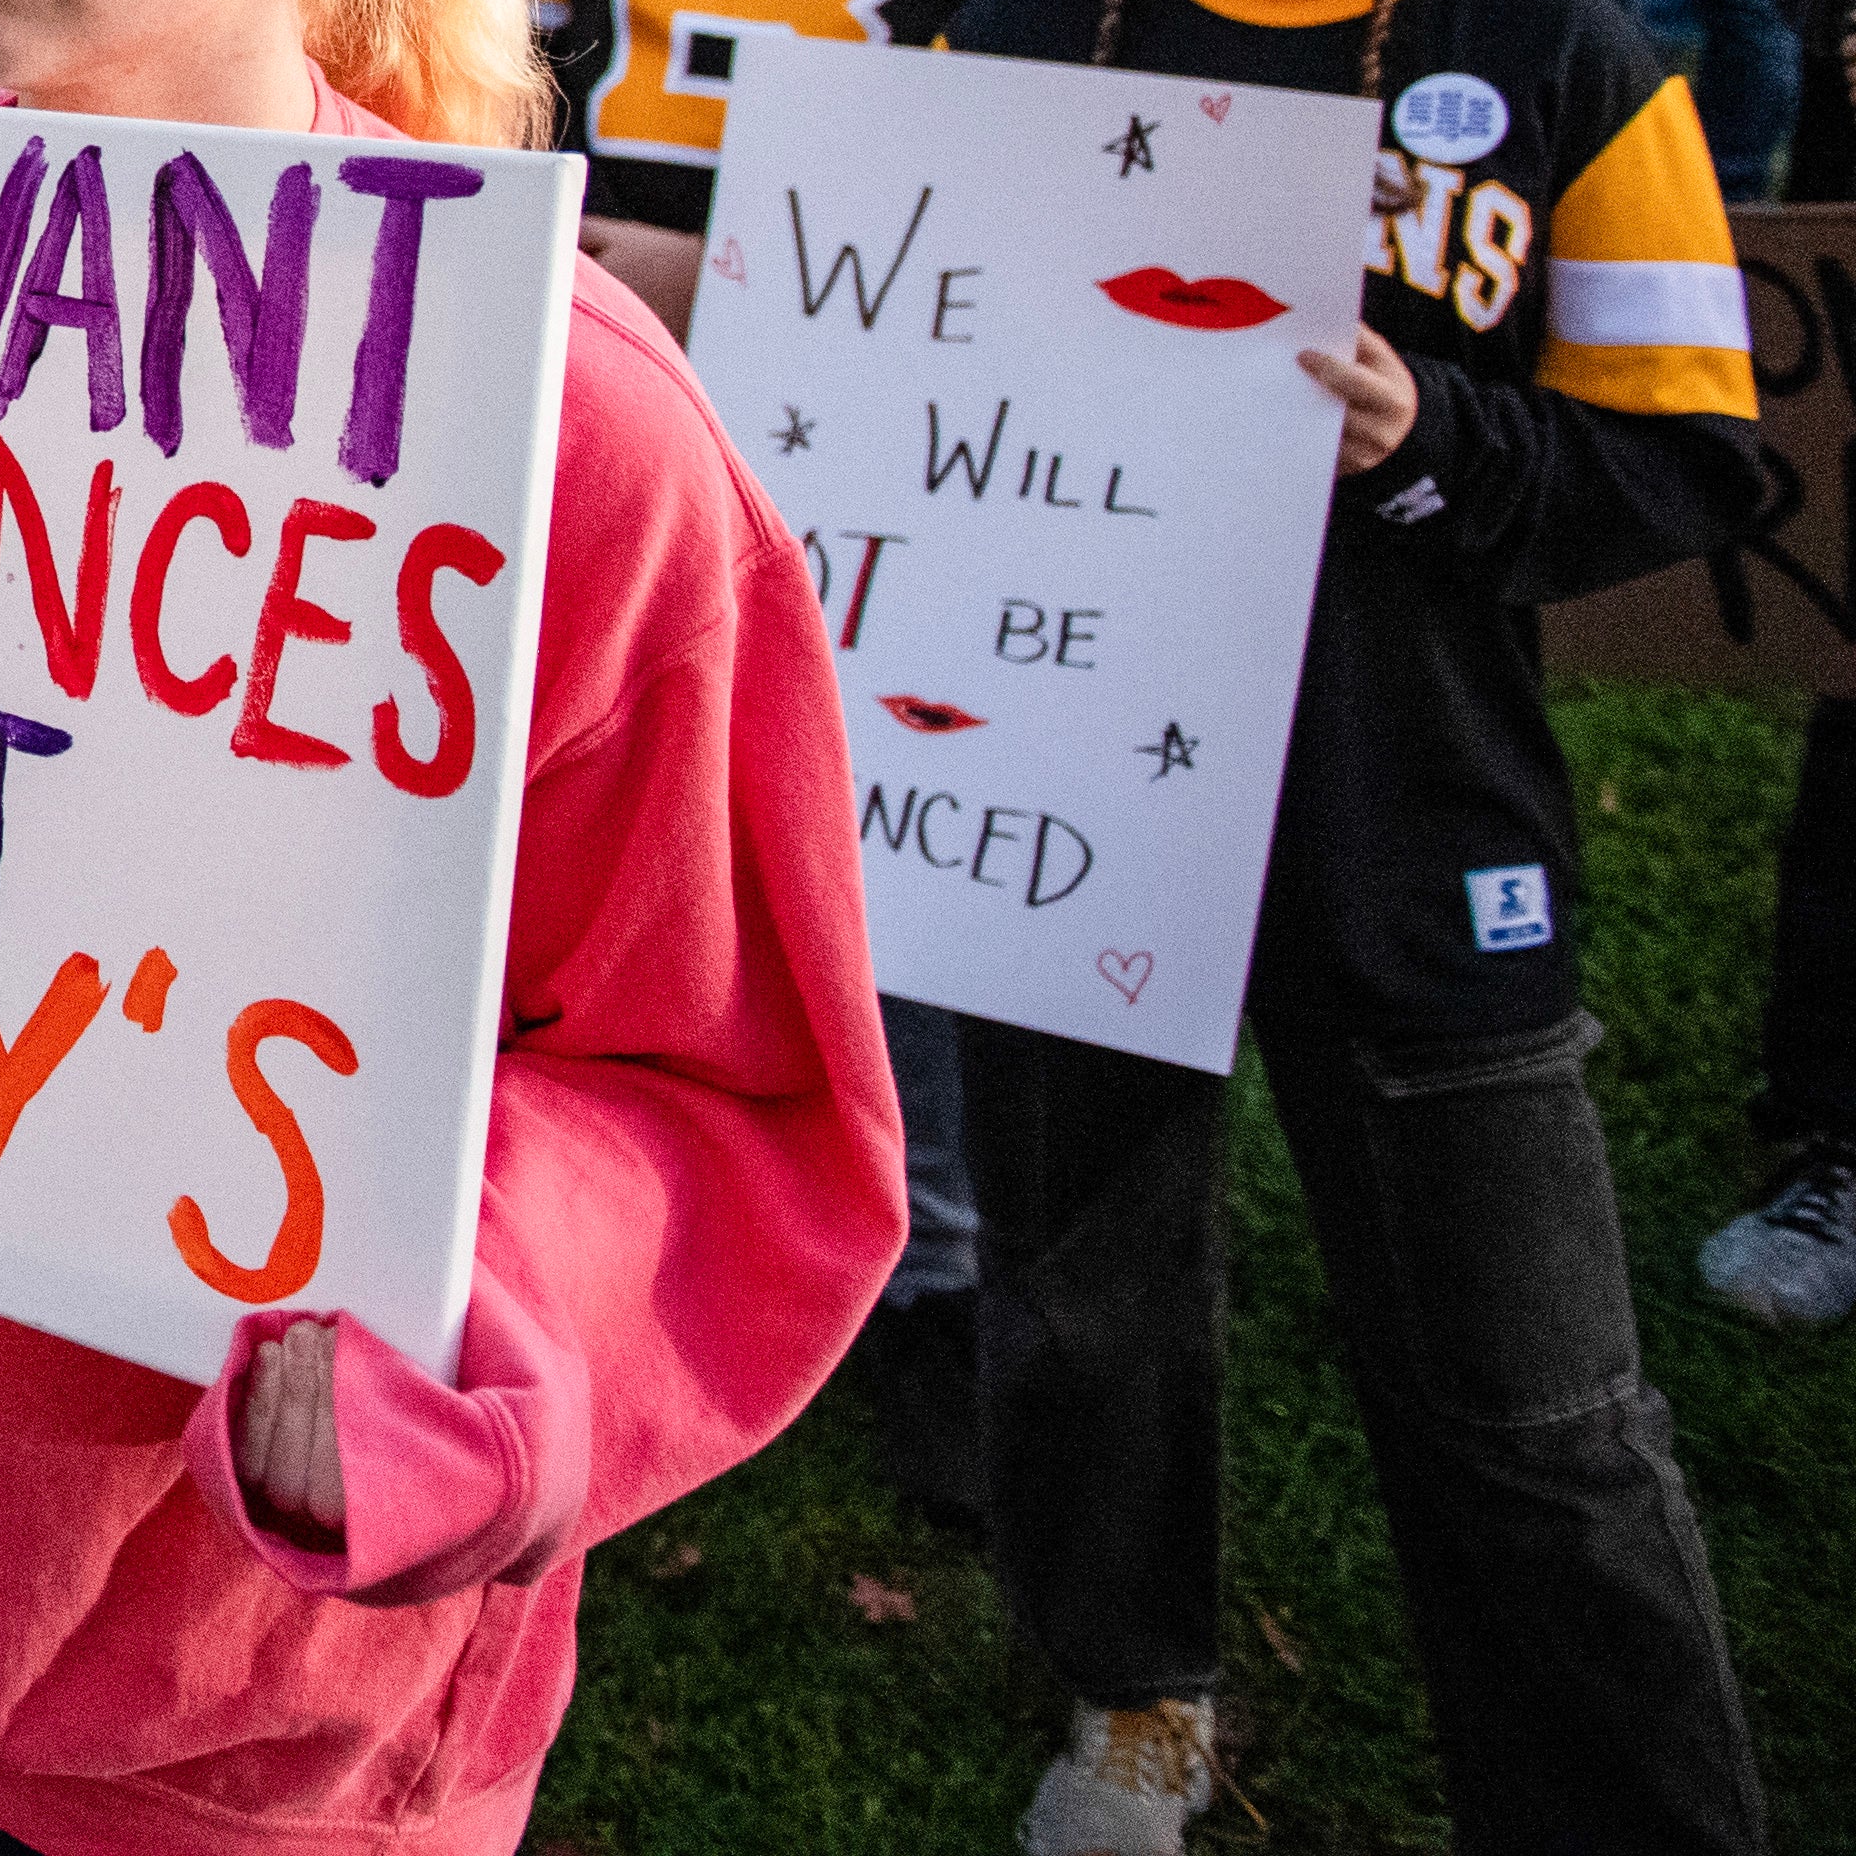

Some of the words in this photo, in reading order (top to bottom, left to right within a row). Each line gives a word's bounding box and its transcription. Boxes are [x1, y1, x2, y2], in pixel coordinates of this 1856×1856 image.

[787, 185, 984, 345] WE
[1362, 146, 1534, 334] NS
[924, 397, 1159, 518] WILL
[993, 595, 1104, 670] BE
[855, 782, 1095, 909] NCED
